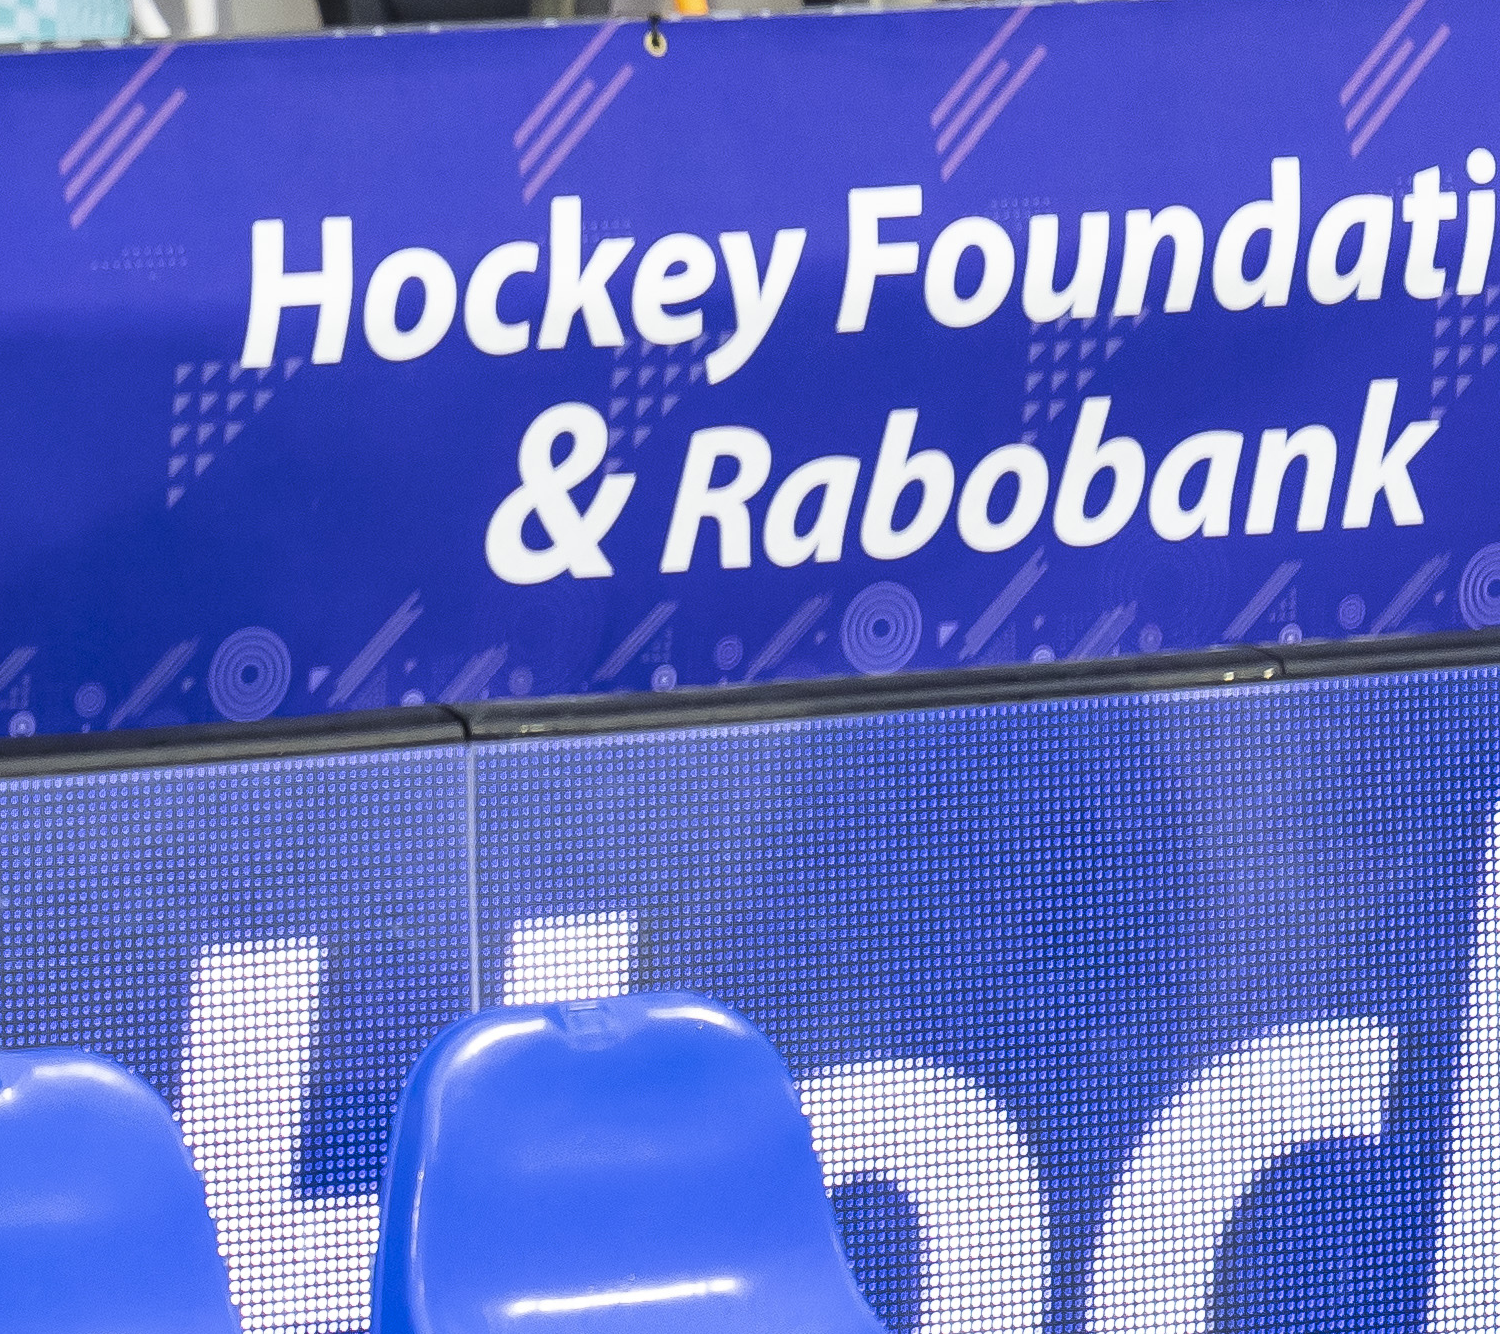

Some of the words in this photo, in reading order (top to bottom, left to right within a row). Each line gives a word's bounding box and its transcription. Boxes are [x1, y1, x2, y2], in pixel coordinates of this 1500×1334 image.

[240, 195, 807, 385] Hockey
[836, 147, 1497, 334] Foundati
[485, 402, 636, 585] &
[660, 378, 1441, 573] Rabobank
